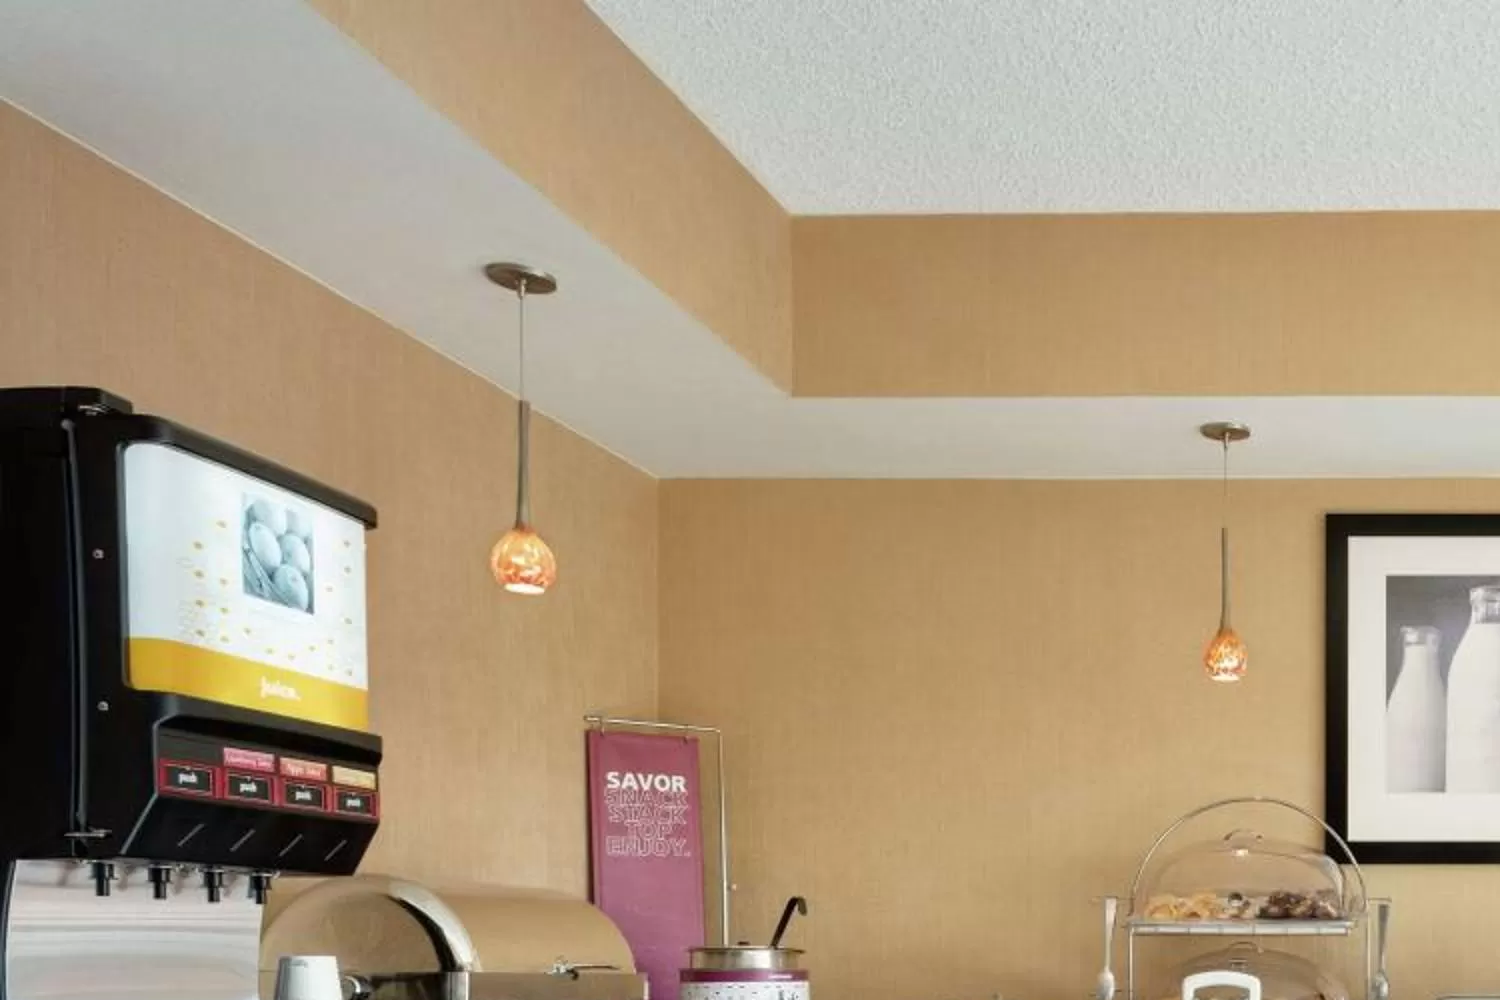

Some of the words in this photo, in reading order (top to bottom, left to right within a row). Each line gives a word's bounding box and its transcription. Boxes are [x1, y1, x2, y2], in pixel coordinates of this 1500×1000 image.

[606, 771, 687, 792] SAVOR
[604, 788, 688, 807] SNACK
[608, 803, 688, 825] STACK
[624, 820, 672, 841] TOP
[606, 835, 691, 857] ENJOY.
